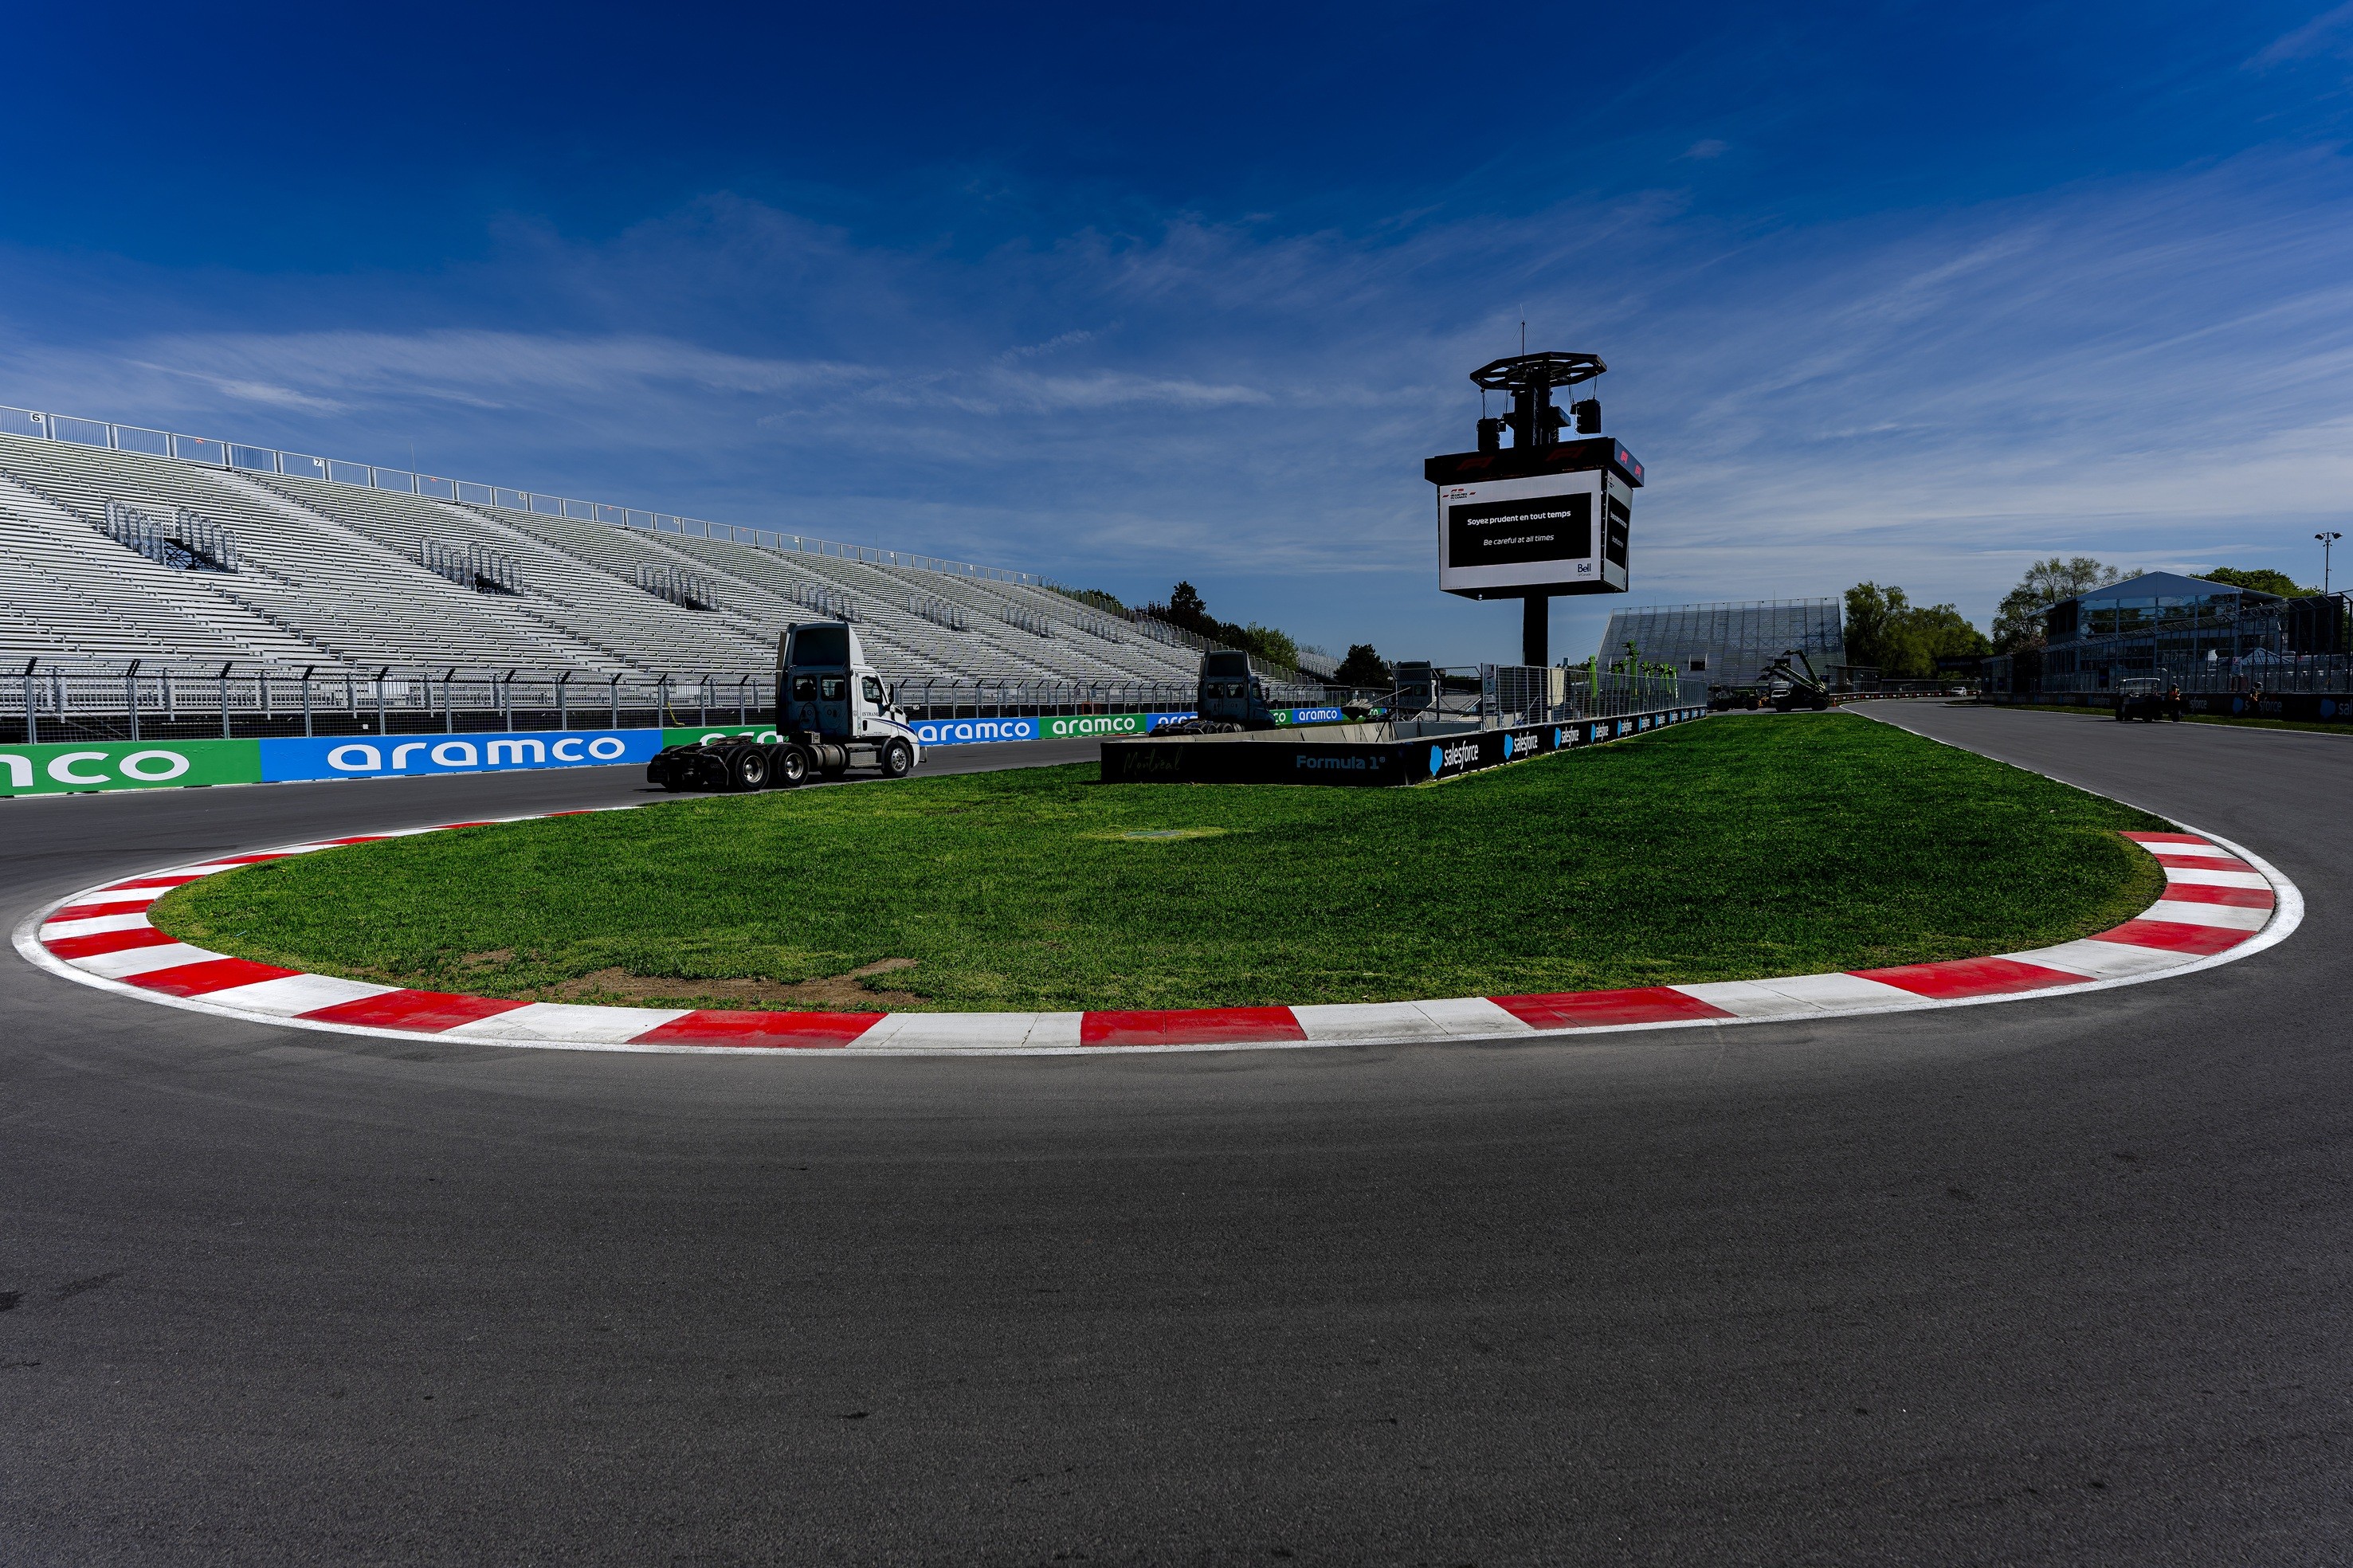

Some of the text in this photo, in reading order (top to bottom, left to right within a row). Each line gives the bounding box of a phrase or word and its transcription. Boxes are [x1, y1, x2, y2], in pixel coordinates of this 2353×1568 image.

[1489, 515, 1519, 524] prudent
[1547, 510, 1571, 519] temps
[1493, 536, 1517, 545] careful
[1578, 563, 1591, 573] Bell
[1298, 708, 1338, 721] aramco
[918, 722, 1030, 742] aramco
[1052, 717, 1135, 735] aramco
[1596, 722, 1609, 741] salesforce
[1513, 731, 1538, 756] salesforce
[1561, 725, 1579, 747] salesforce
[327, 737, 626, 771] aramco
[1296, 755, 1366, 770] Formula
[1444, 739, 1479, 770] salesforce
